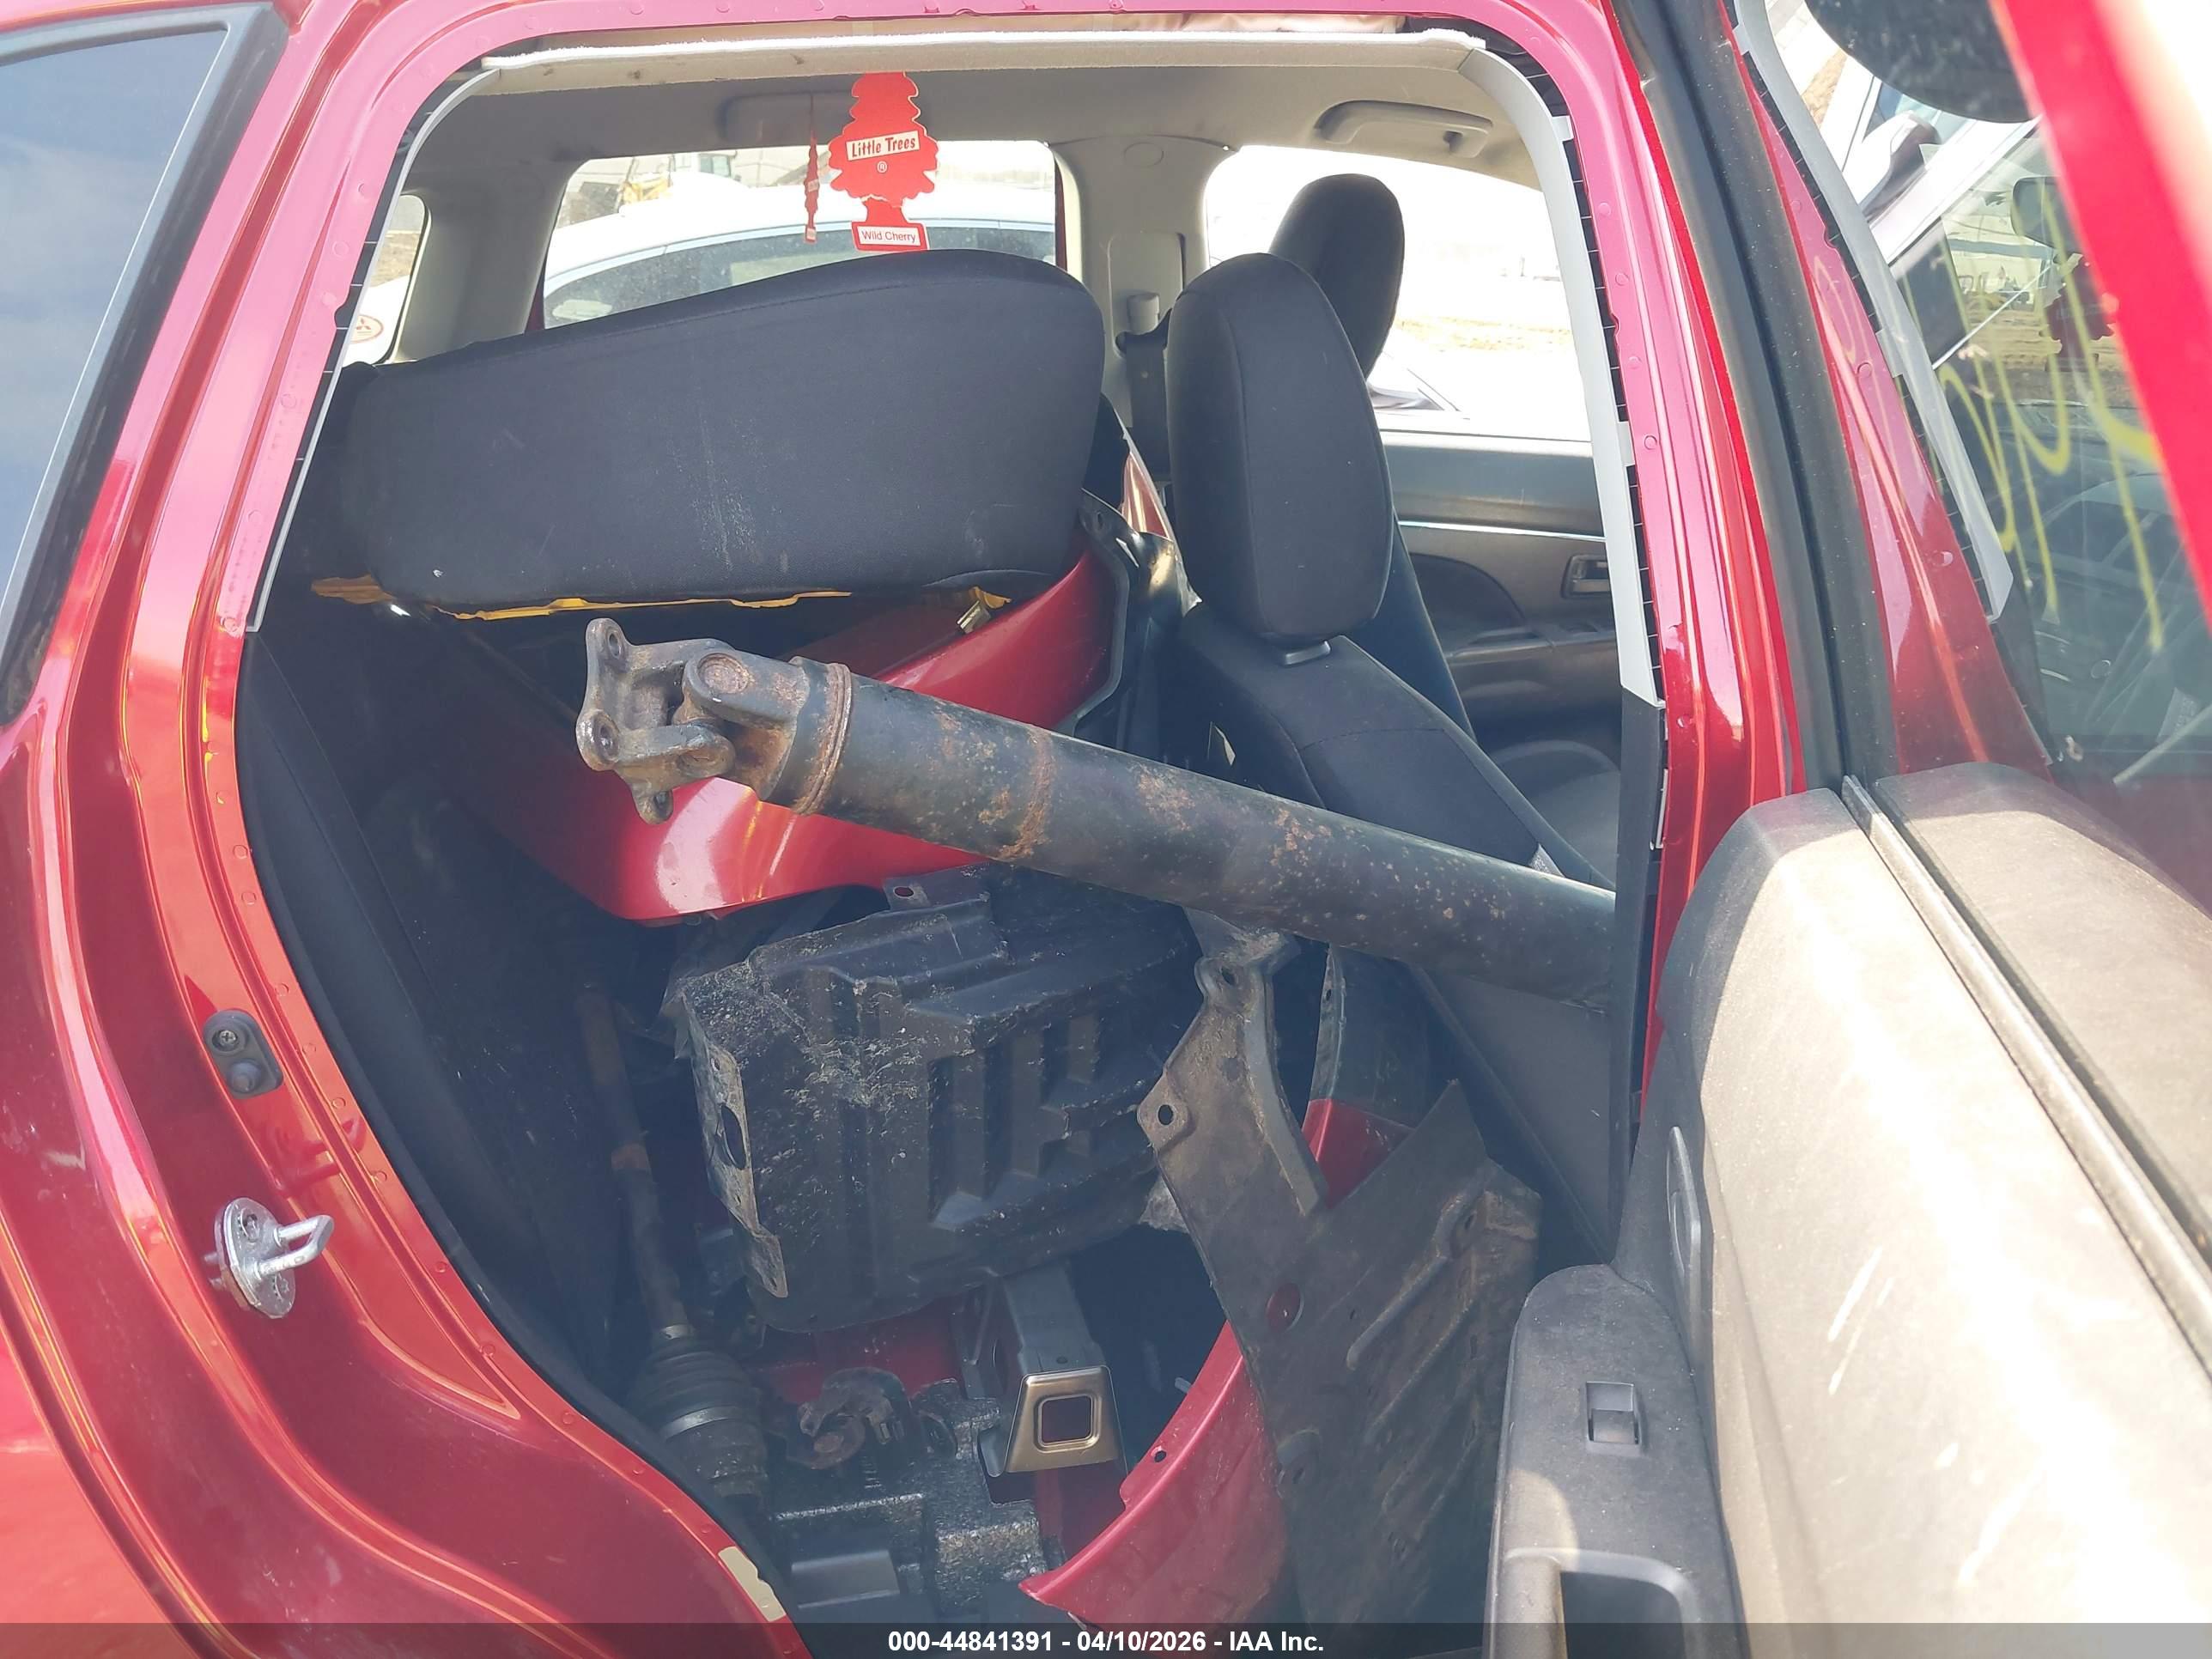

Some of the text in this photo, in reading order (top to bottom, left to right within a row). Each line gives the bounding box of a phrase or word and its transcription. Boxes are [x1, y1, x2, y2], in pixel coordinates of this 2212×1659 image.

[852, 137, 915, 157] Little Trees
[861, 231, 916, 244] Wild Cherry
